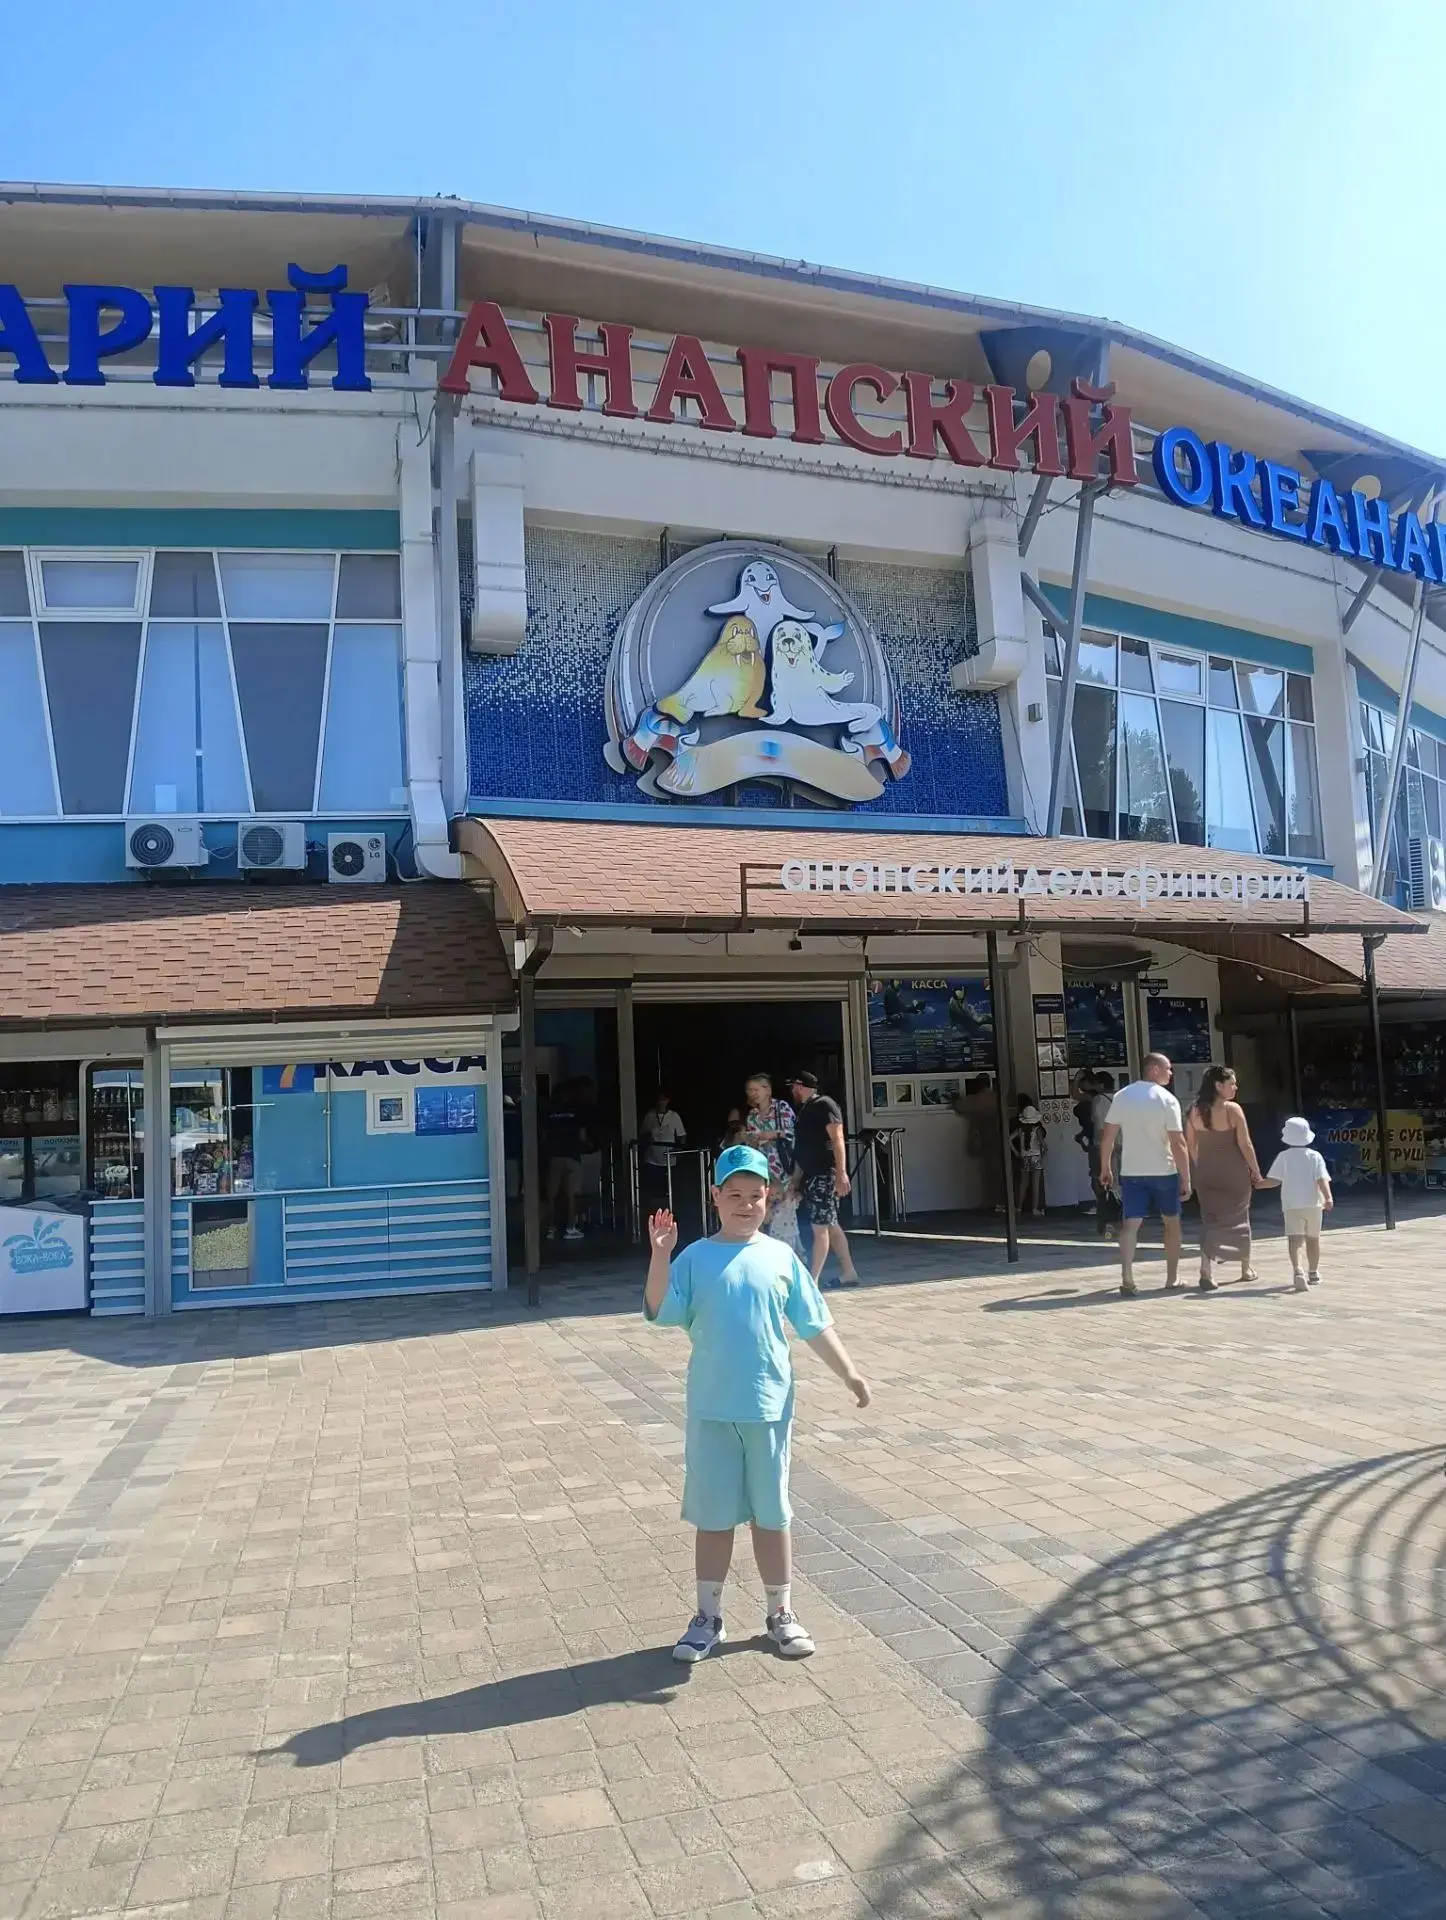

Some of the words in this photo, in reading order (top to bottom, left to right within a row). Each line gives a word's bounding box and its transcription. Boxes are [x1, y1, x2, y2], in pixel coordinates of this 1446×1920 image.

[440, 301, 1140, 487] АНАПСКИЙ
[911, 979, 948, 989] КАССА
[1328, 1128, 1394, 1143] МОРСКЕ
